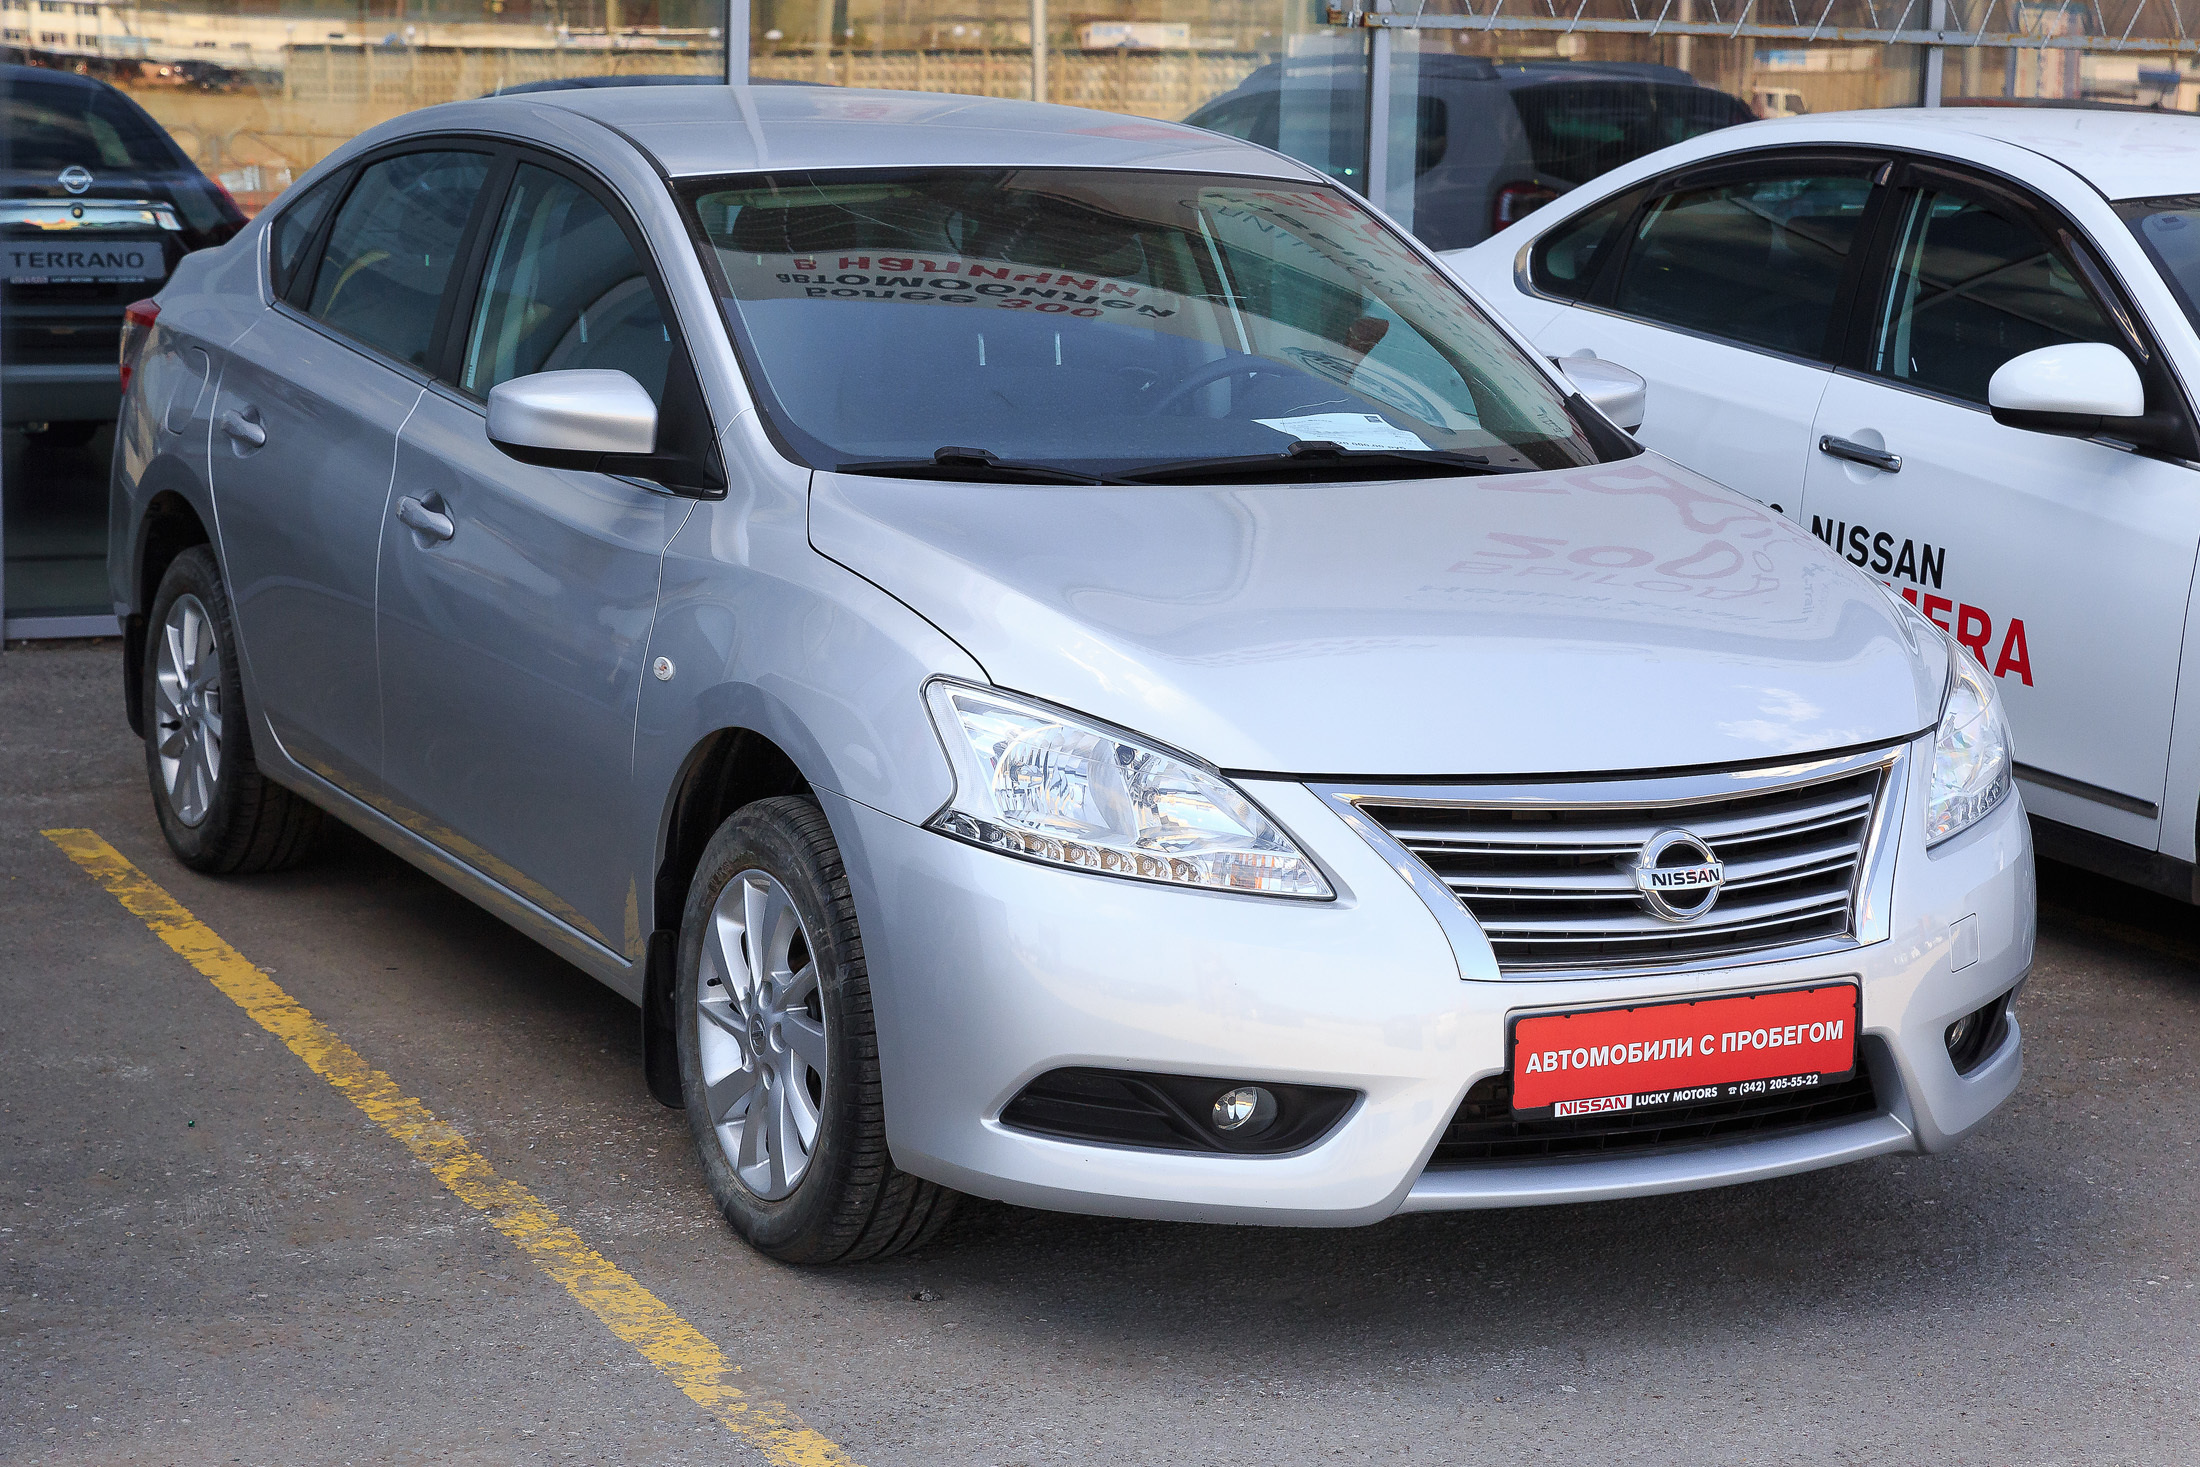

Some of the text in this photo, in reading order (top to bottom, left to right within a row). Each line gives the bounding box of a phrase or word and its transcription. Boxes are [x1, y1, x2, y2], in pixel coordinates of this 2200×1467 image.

[8, 251, 145, 269] TERRANO
[1811, 514, 1946, 590] NISSAN
[1651, 867, 1720, 887] NISSAN
[1524, 1020, 1844, 1074] АВТОМОБИЛИ С ПРОБЕГОМ
[1559, 1073, 1819, 1116] NISSAN LUCKY MOTORS (342) 205-55-22
